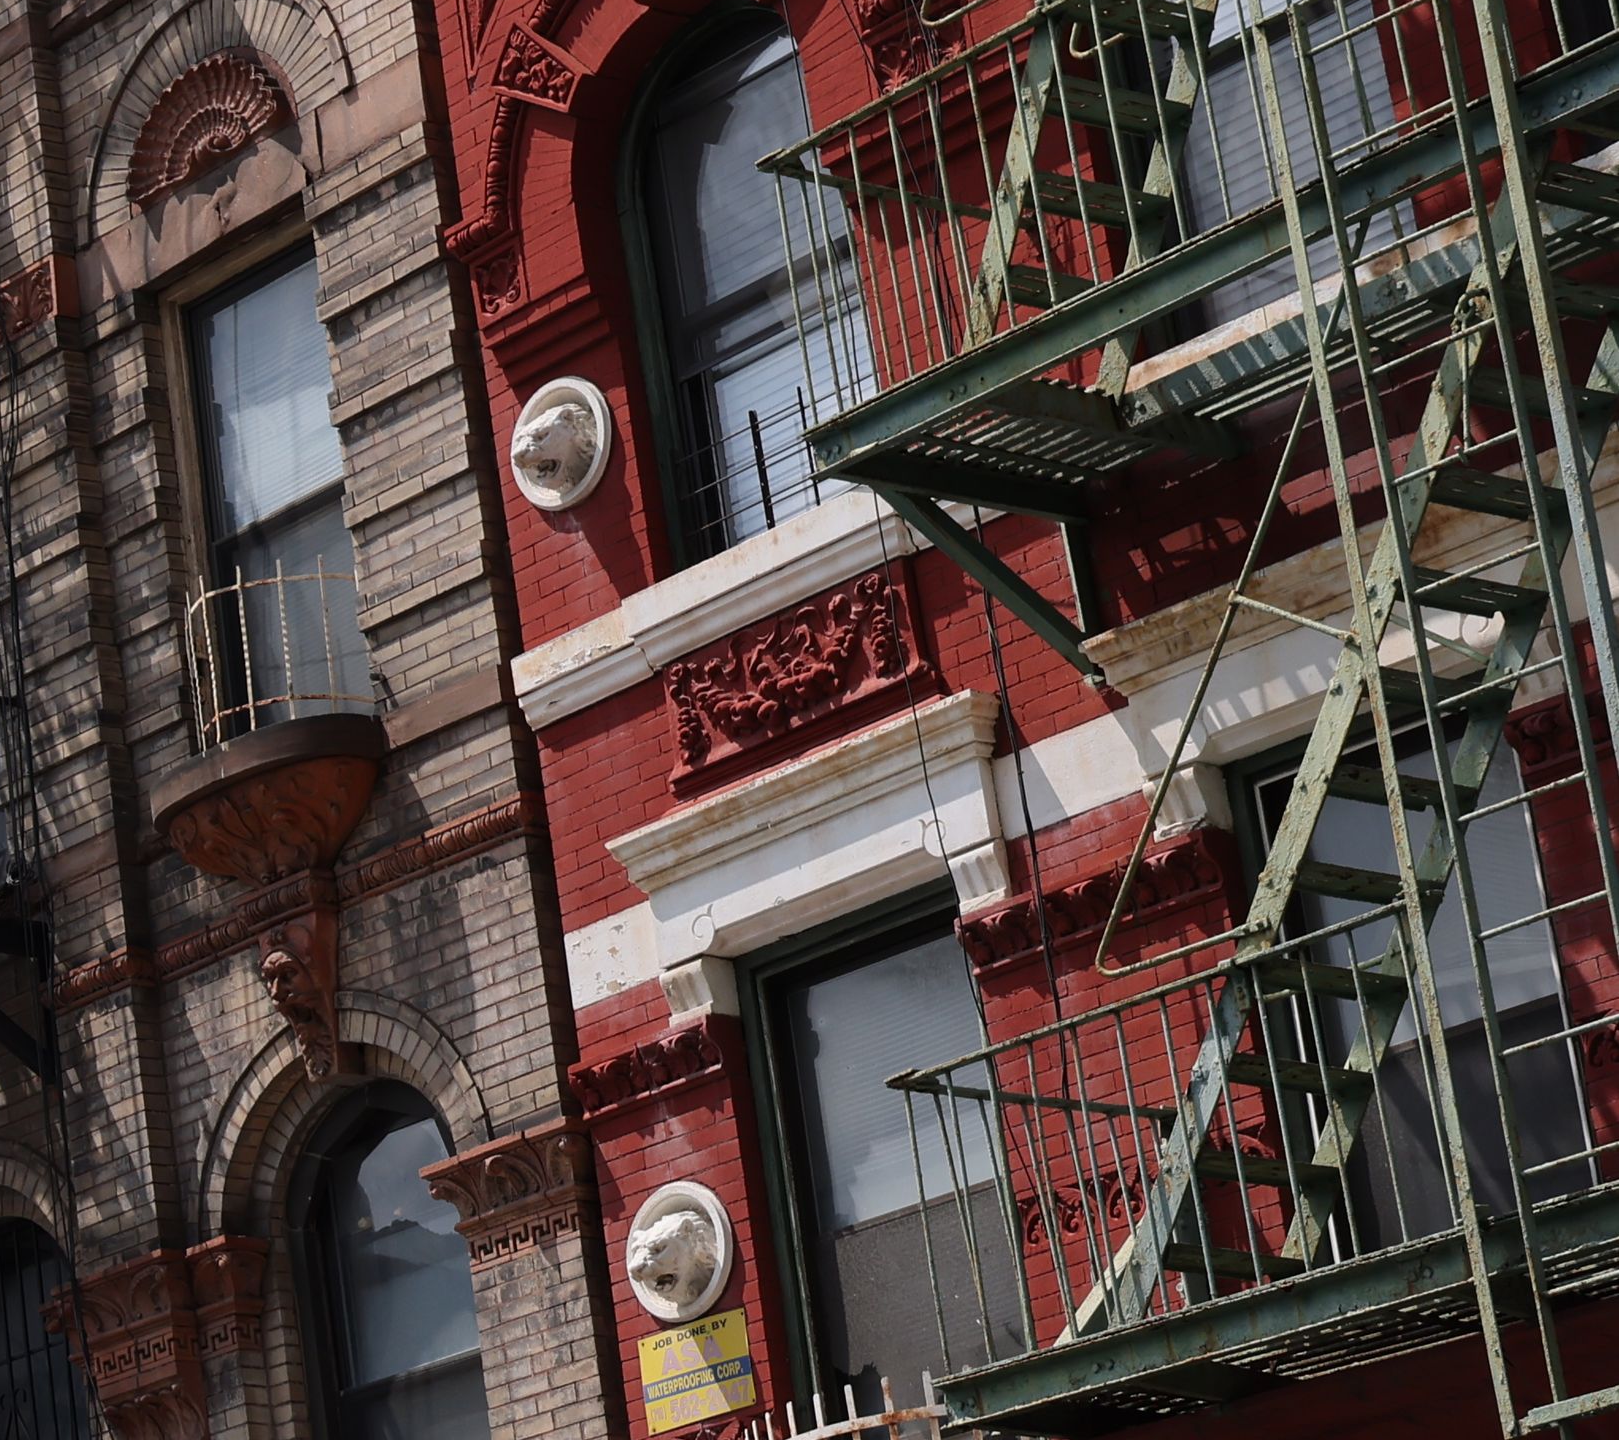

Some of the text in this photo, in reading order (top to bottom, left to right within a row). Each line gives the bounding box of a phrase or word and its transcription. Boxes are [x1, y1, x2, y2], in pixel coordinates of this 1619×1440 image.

[652, 1318, 727, 1351] JOB DONE BY
[647, 1360, 744, 1400] WATERPROOFING CORP.
